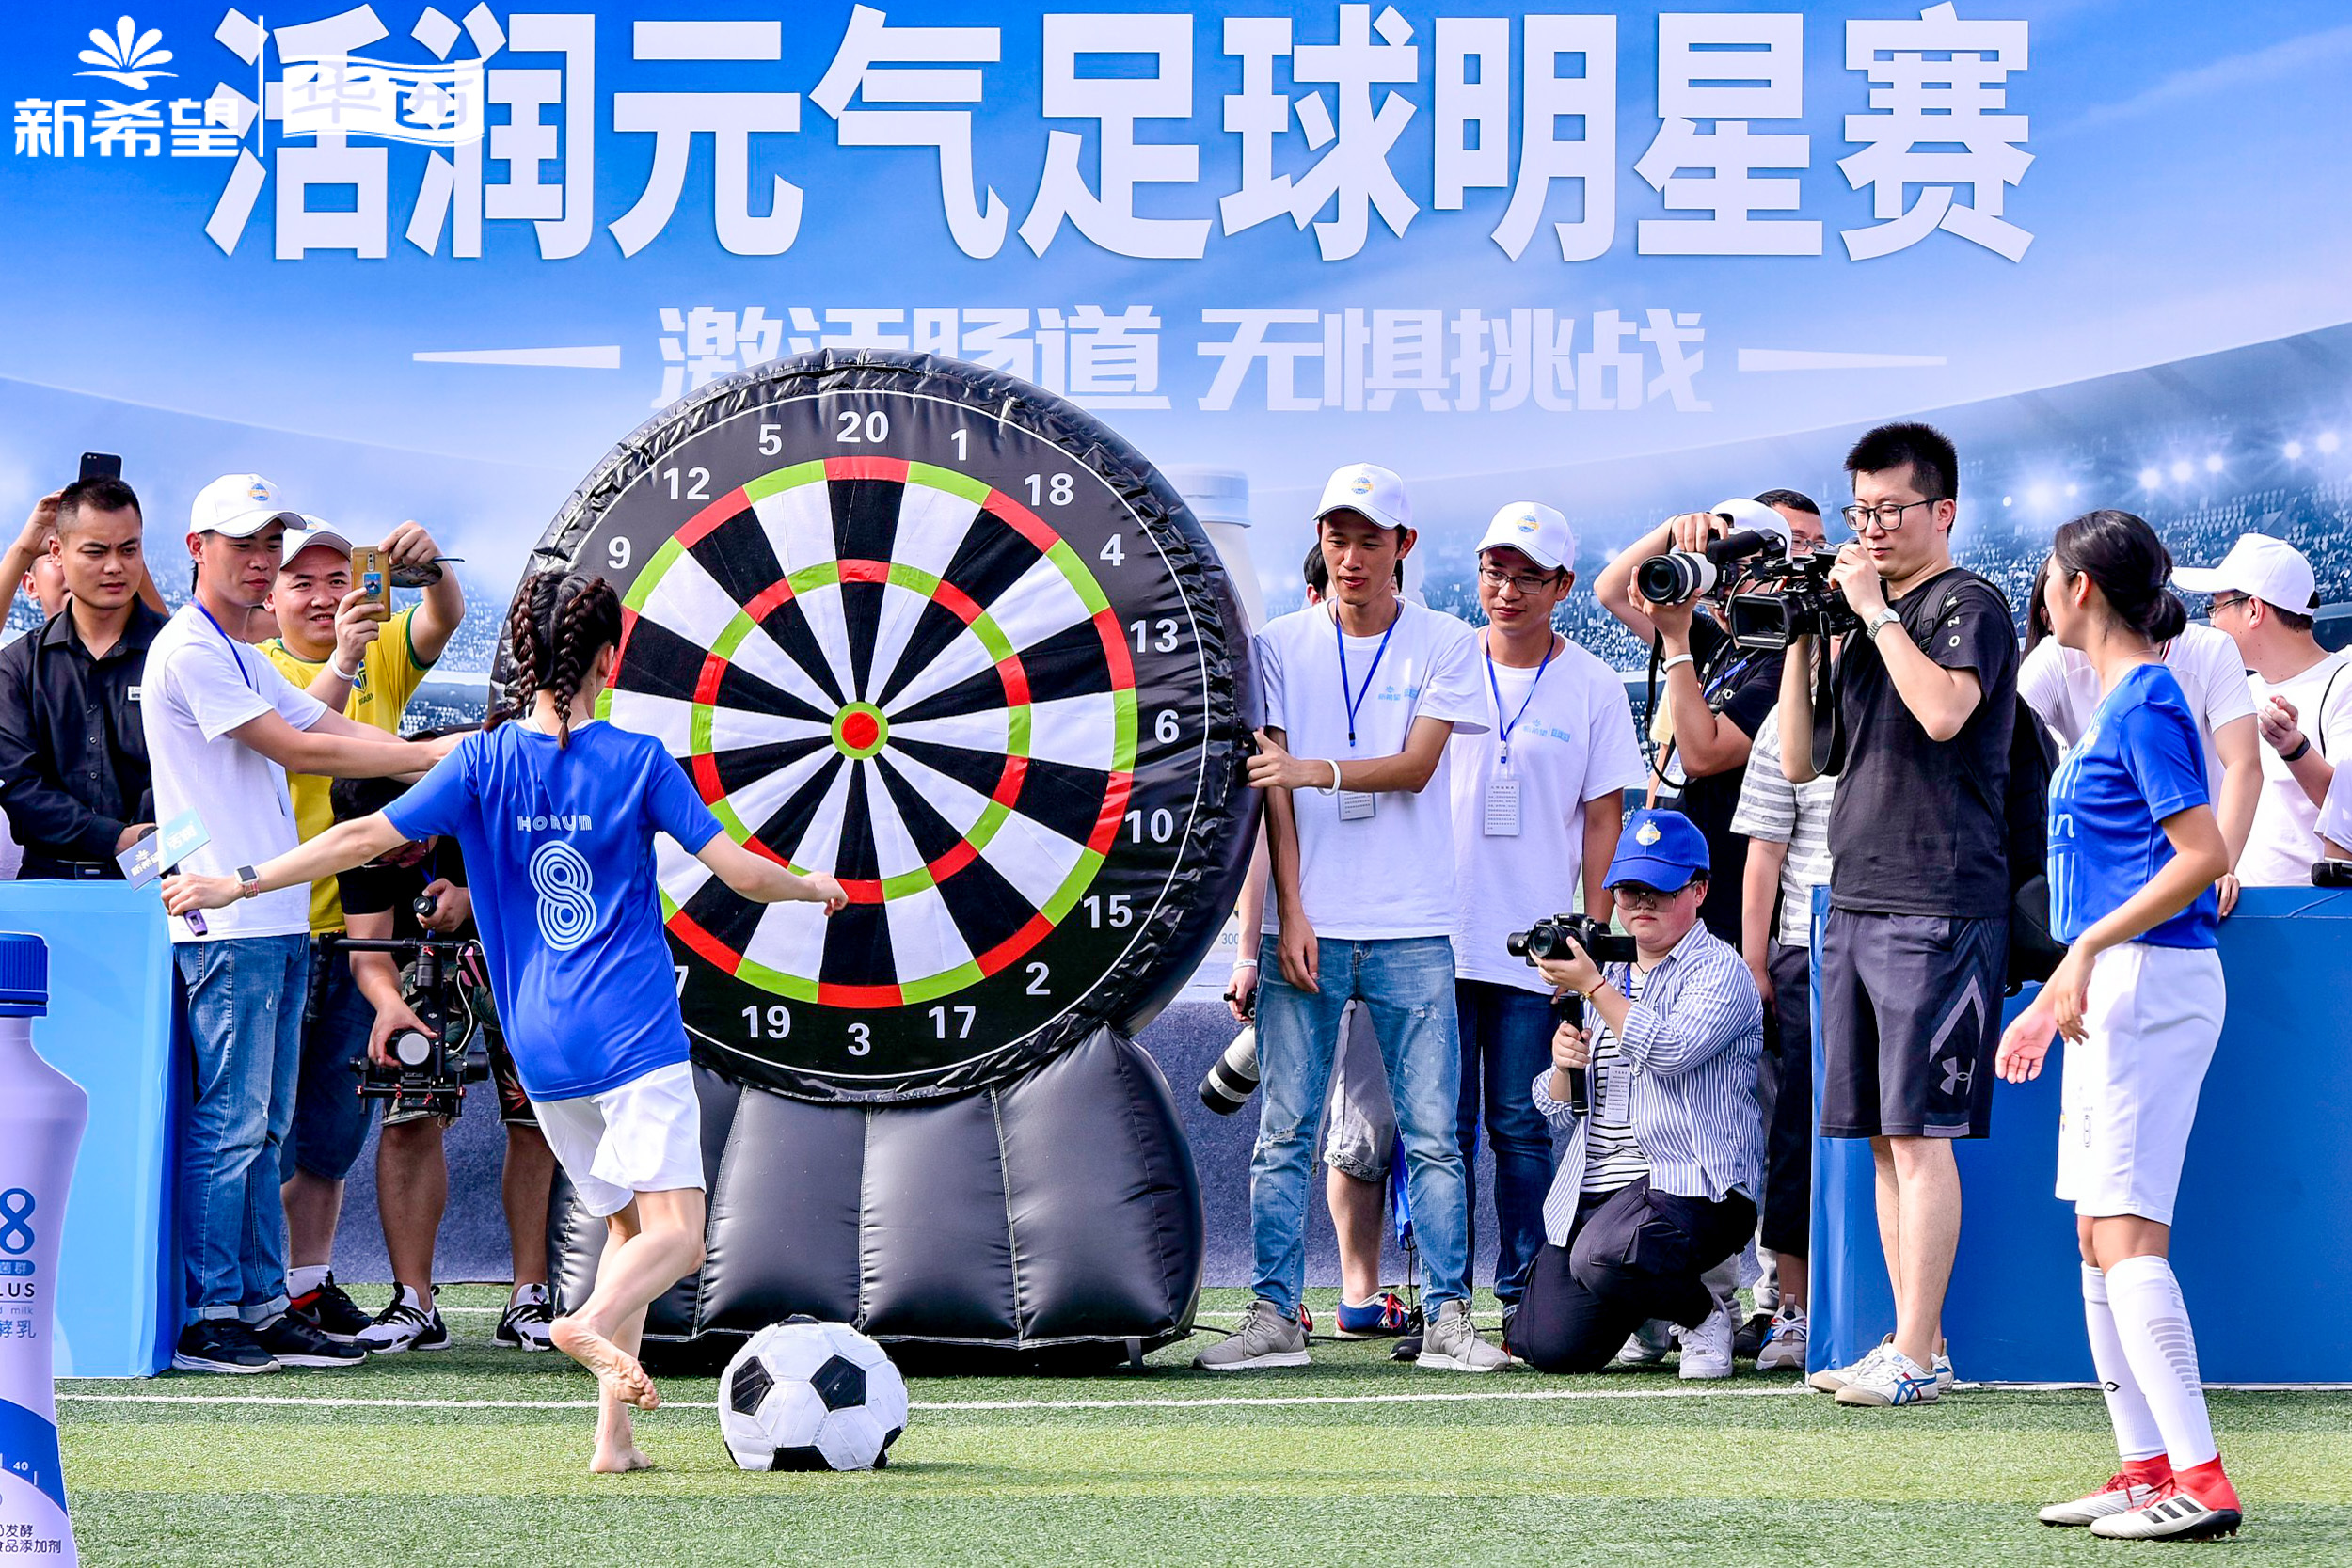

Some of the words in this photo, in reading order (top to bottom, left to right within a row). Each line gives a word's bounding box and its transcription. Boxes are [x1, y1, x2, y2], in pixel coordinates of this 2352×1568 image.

[204, 2, 2035, 263] 活润元气足球明星赛
[1197, 307, 1714, 412] 无惧挑战
[759, 424, 783, 457] 5
[837, 411, 889, 443] 20
[951, 429, 967, 461] 1
[663, 467, 710, 500] 12
[1025, 473, 1073, 506] 18
[608, 536, 631, 569] 9
[1100, 534, 1125, 566] 4
[1130, 619, 1179, 653] 13
[1155, 710, 1180, 743] 6
[1125, 808, 1173, 844] 10
[529, 839, 597, 952] 8
[1084, 895, 1133, 928] 15
[1026, 962, 1051, 995] 2
[742, 1006, 790, 1039] 19
[929, 1006, 976, 1039] 17
[848, 1023, 870, 1056] 3
[11, 1306, 34, 1315] milk
[13, 1461, 29, 1471] 40
